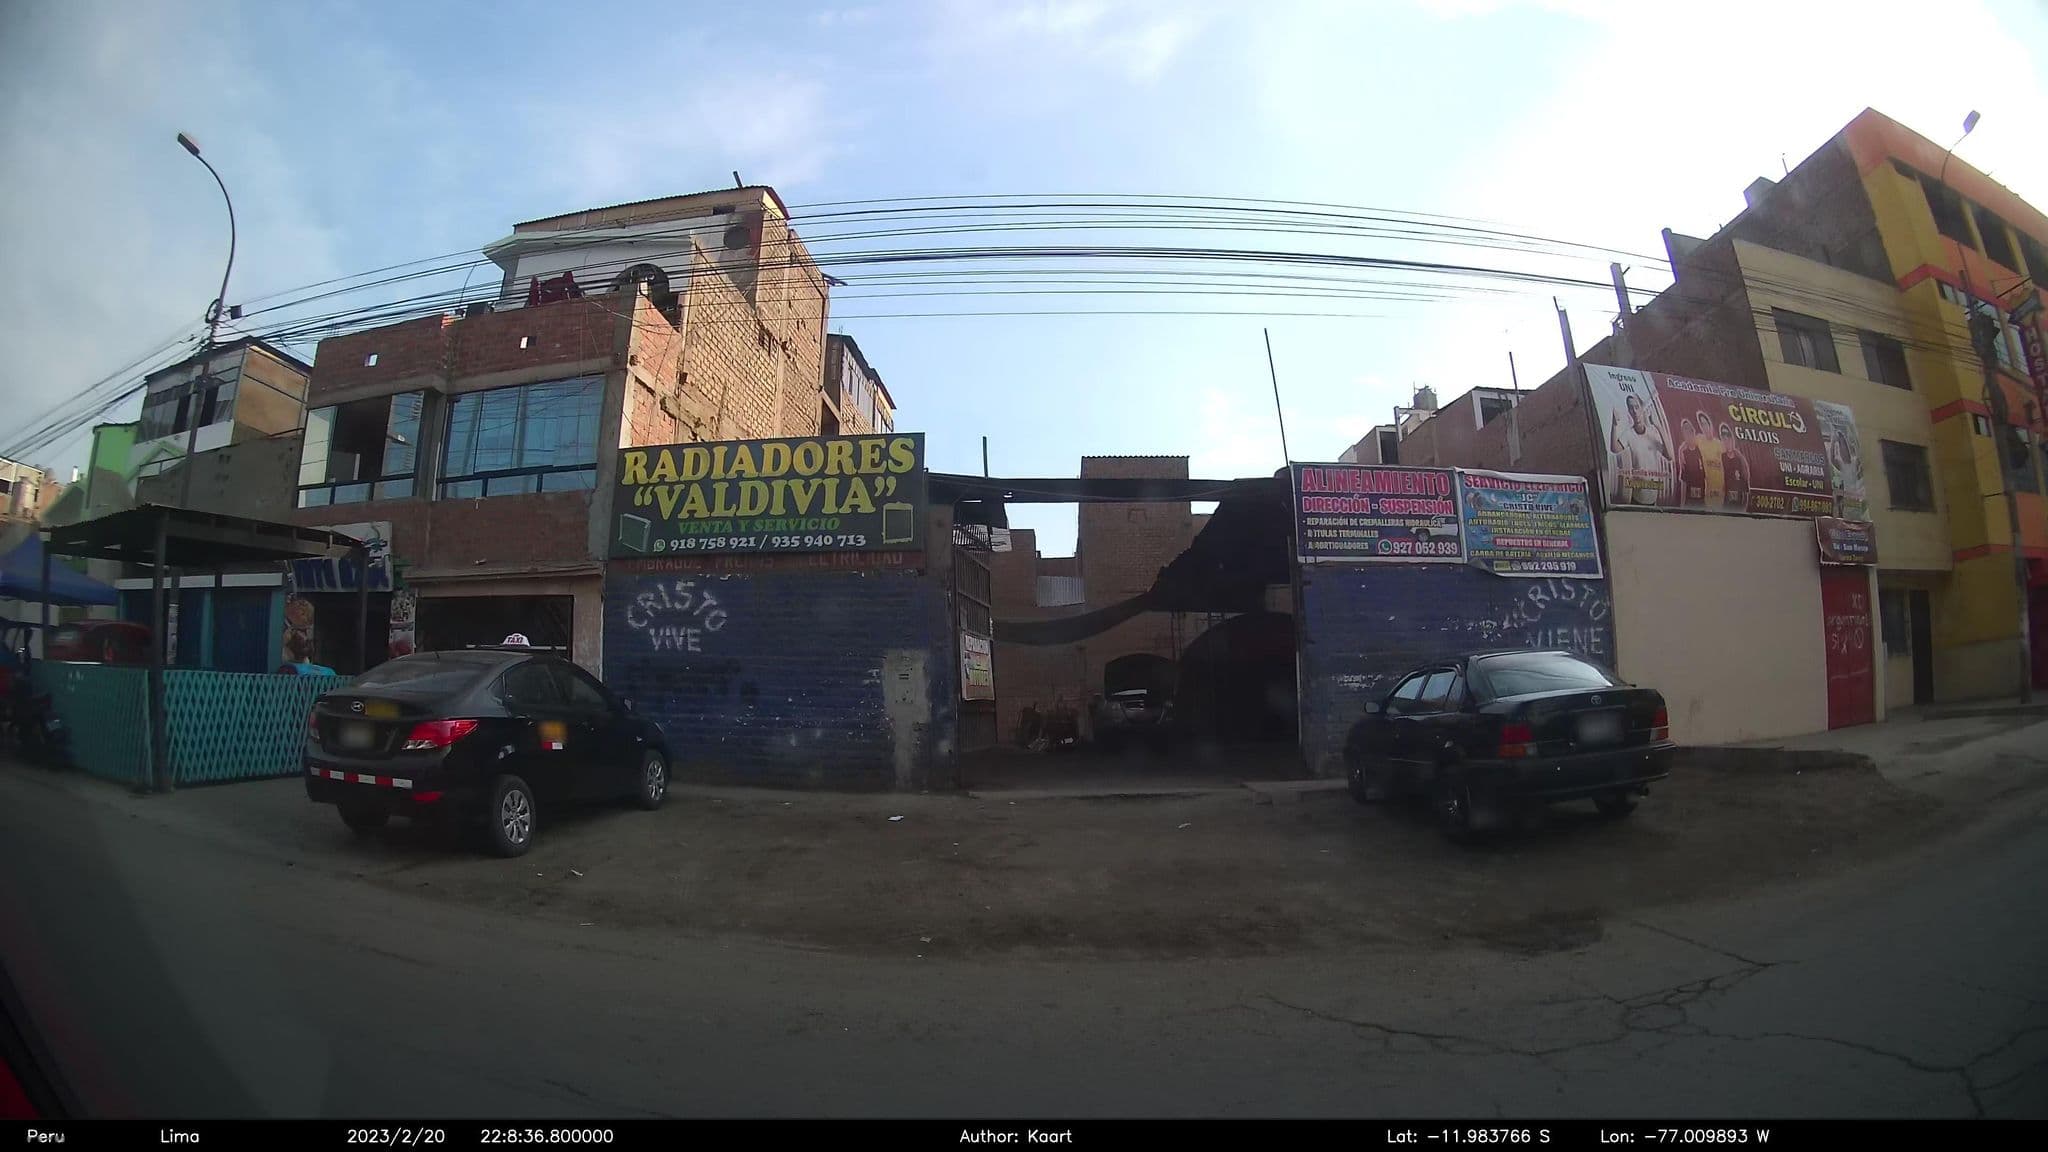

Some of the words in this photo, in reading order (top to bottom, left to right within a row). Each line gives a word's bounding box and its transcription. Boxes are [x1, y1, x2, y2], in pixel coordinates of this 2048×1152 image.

[1618, 383, 1635, 393] UNI
[1735, 426, 1780, 444] GALOIS
[621, 438, 915, 485] RADIADORES
[1302, 468, 1450, 496] ALINEAMIENTO
[1303, 494, 1371, 513] DIRECCIÓN
[1379, 496, 1456, 515] SUSPENSIÓN
[679, 519, 733, 534] VENTA
[739, 519, 750, 533] Y
[753, 517, 841, 533] SERVICIO
[670, 538, 696, 551] 918
[699, 537, 726, 550] 758
[729, 536, 757, 549] 921
[771, 536, 800, 548] 935
[804, 535, 833, 547] 940
[836, 534, 867, 546] 713
[1392, 541, 1412, 554] 927
[1438, 542, 1458, 555] 939
[628, 581, 728, 631] CRISTO
[649, 627, 702, 653] VIVE
